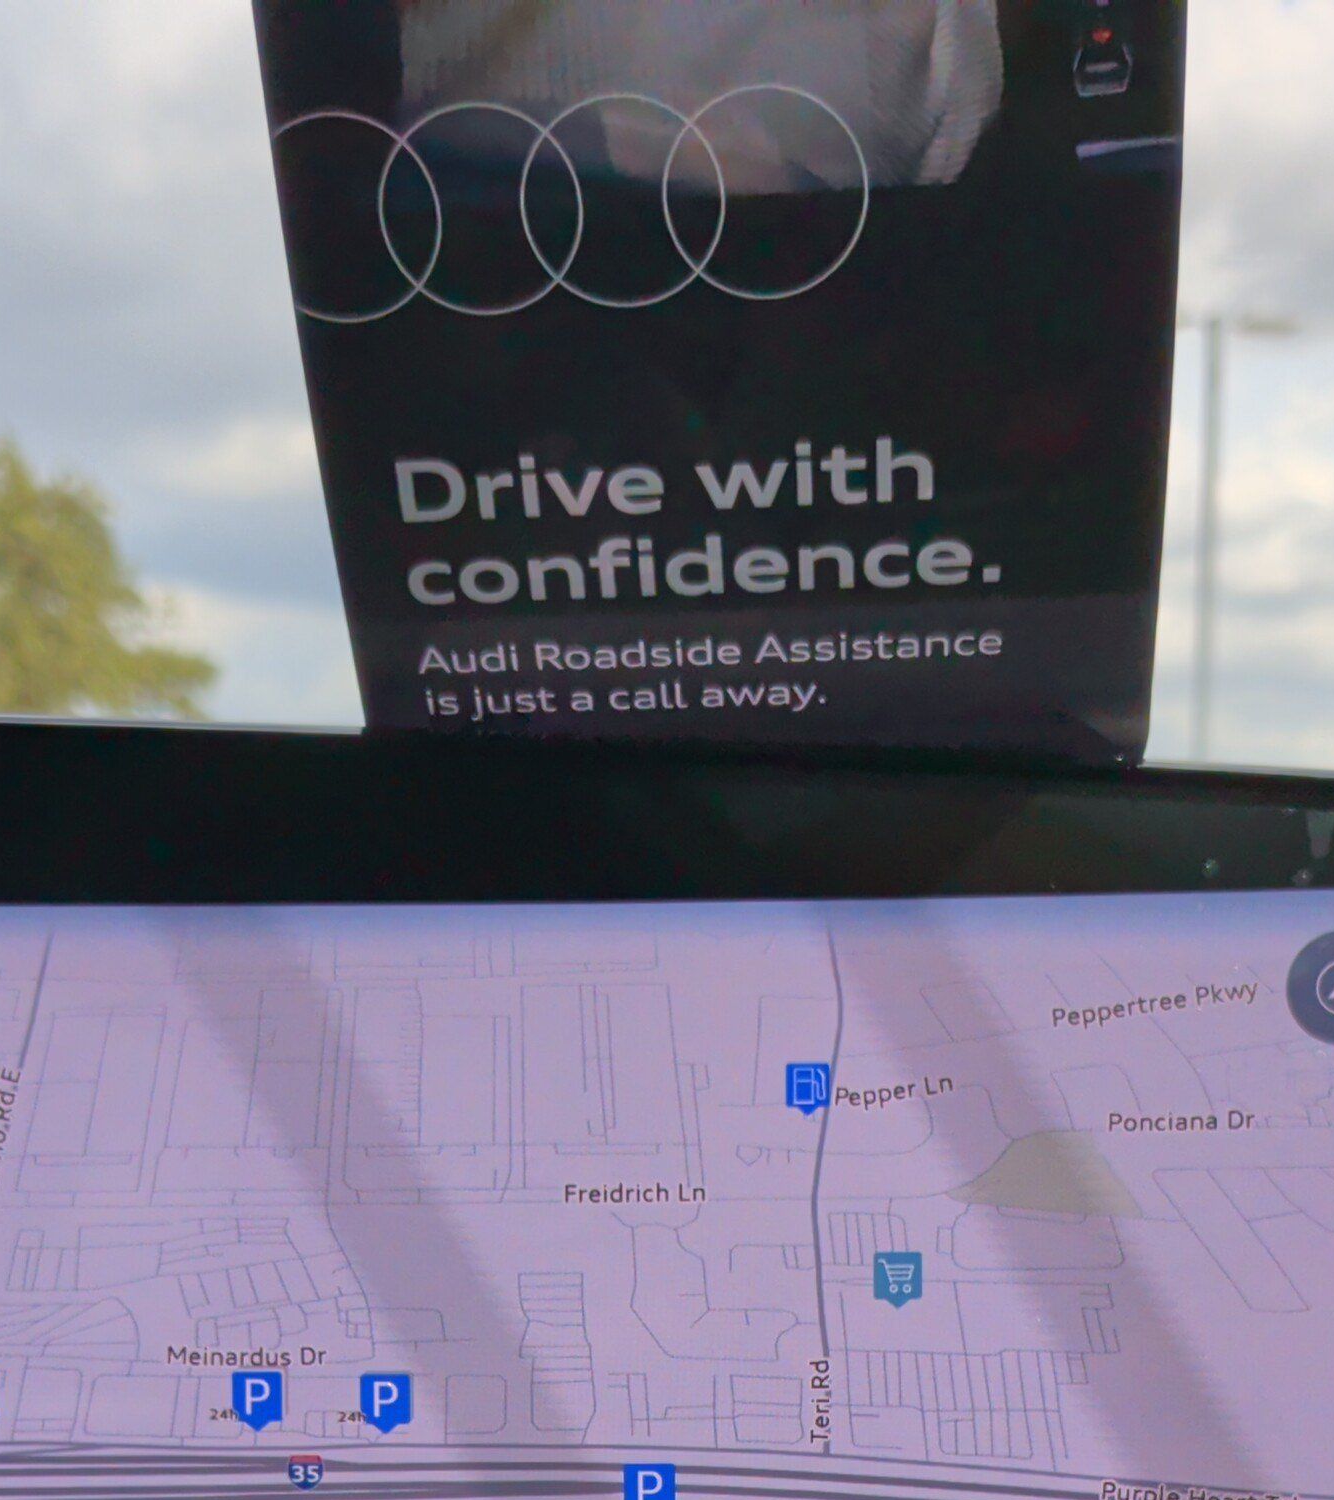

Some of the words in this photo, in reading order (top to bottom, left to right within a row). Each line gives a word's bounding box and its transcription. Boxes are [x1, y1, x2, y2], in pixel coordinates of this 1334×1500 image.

[396, 455, 664, 523] Drive
[697, 437, 935, 509] with
[408, 533, 1002, 606] confidence.
[419, 643, 519, 676] Audi
[535, 638, 742, 672] Roadside
[754, 628, 1003, 667] Assistance
[426, 687, 459, 717] is
[469, 682, 556, 721] just
[569, 687, 595, 713] a
[609, 679, 687, 713] call
[701, 682, 827, 717] away.
[1052, 992, 1187, 1029] Peppertree
[1196, 982, 1259, 1005] Pkwy
[0, 1067, 21, 1084] E
[835, 1080, 916, 1111] Pepper
[924, 1076, 953, 1095] Ln
[1108, 1111, 1218, 1133] Ponciana
[1228, 1110, 1255, 1130] Dr
[565, 1184, 669, 1204] Freidrich
[678, 1184, 706, 1202] Ln
[166, 1346, 292, 1368] Meinardus
[300, 1347, 326, 1366] Dr
[810, 1358, 830, 1390] Rd
[244, 1378, 271, 1415] P
[372, 1381, 399, 1418] P
[810, 1399, 830, 1444] Teri
[291, 1465, 319, 1483] 35
